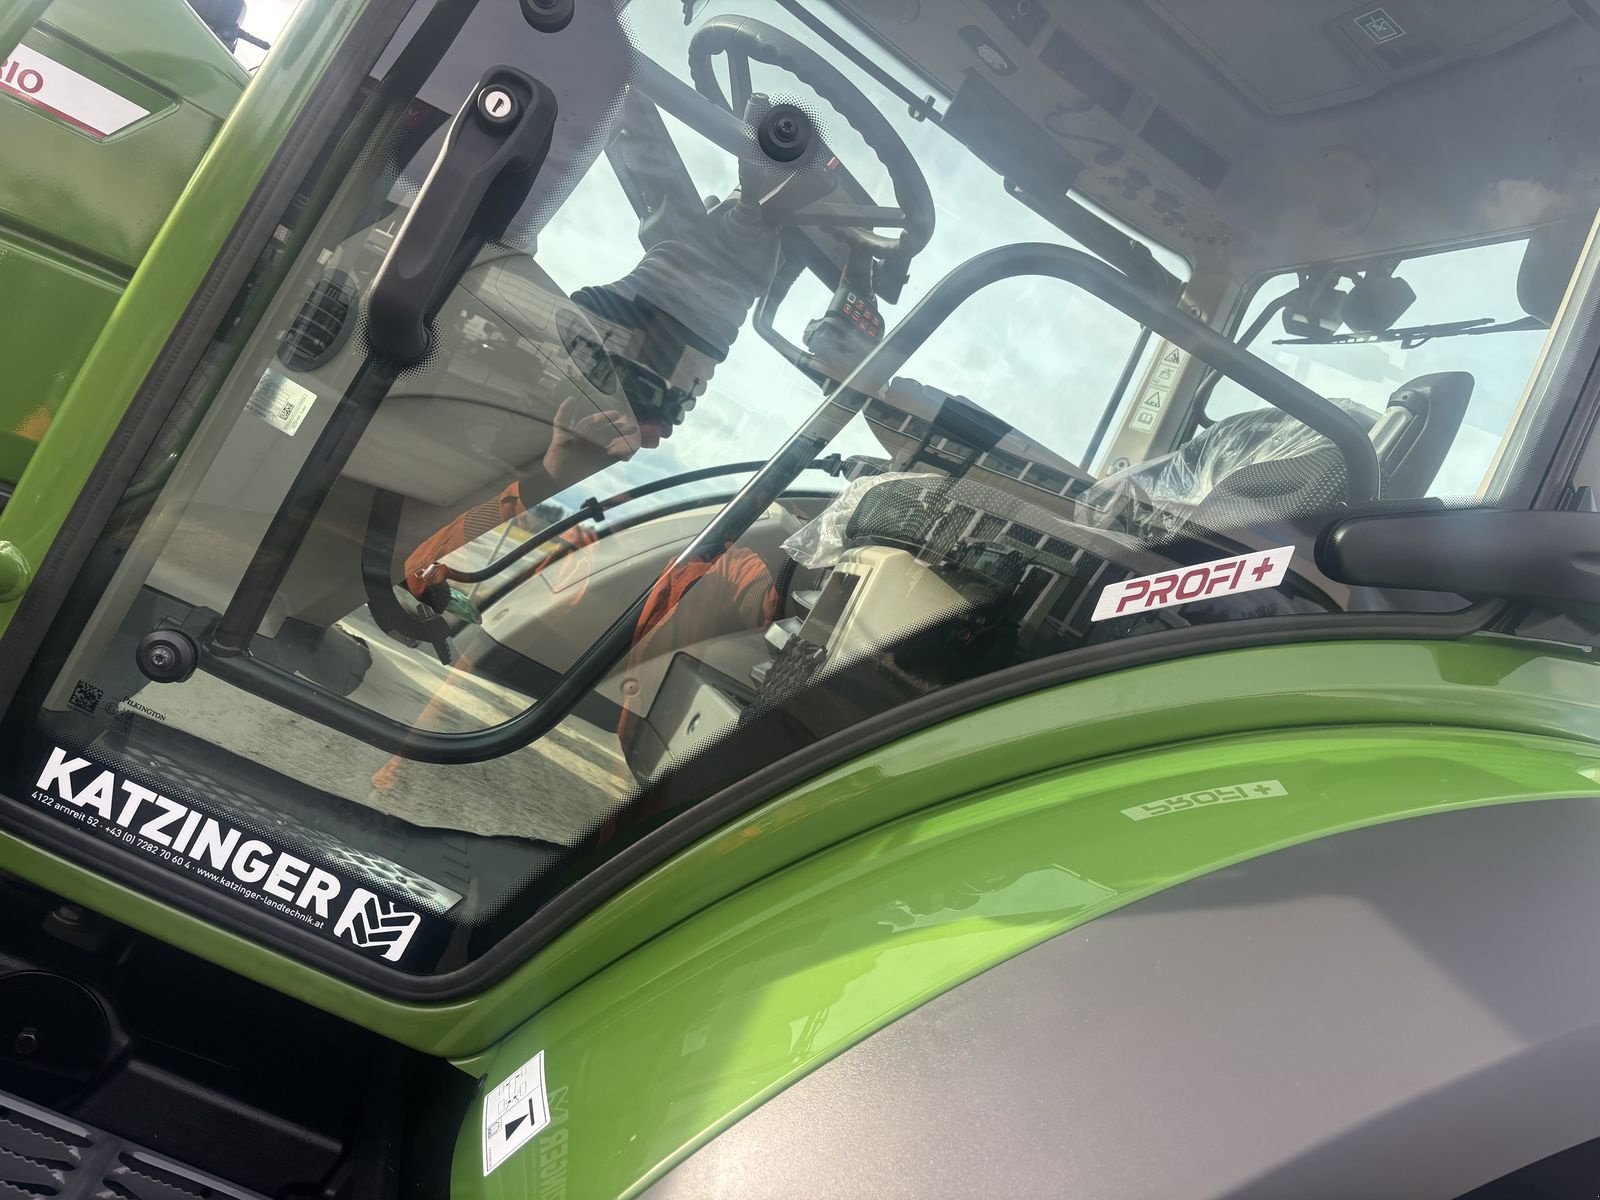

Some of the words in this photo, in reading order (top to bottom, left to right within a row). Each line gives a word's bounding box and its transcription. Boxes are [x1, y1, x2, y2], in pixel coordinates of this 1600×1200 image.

[0, 59, 44, 93] IO
[122, 695, 167, 721] PILKINGTON
[31, 791, 53, 807] 4122
[54, 802, 86, 822] arnreit
[86, 815, 100, 828] 52
[105, 827, 122, 838] +43
[123, 831, 136, 845] (0)
[137, 838, 159, 855] 7282
[160, 848, 172, 860] 70
[172, 855, 184, 866] 60
[184, 861, 191, 869] 4
[197, 867, 324, 929] www.katzinger-landtechnik.at
[35, 746, 341, 919] KATZINGER
